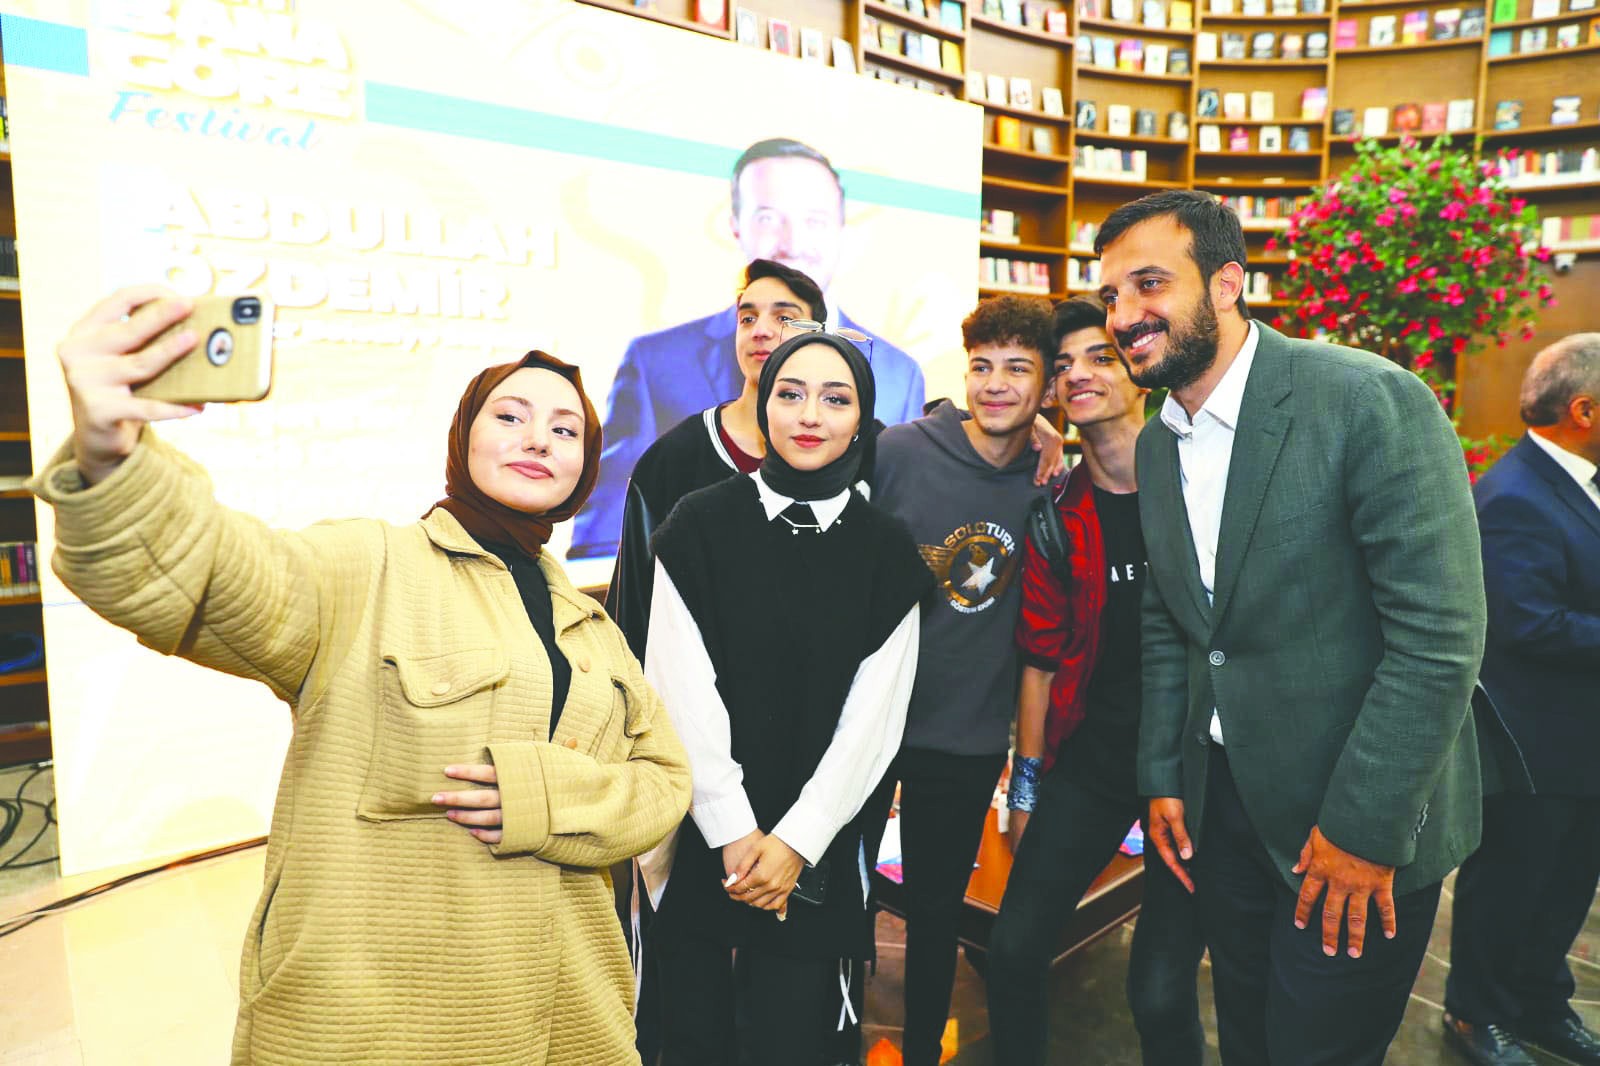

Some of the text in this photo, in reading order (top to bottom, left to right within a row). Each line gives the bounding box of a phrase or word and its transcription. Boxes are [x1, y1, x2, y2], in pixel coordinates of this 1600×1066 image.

[108, 90, 322, 151] Festival
[150, 184, 559, 270] ABDULLAH
[153, 241, 511, 320] ÖZDEMİR
